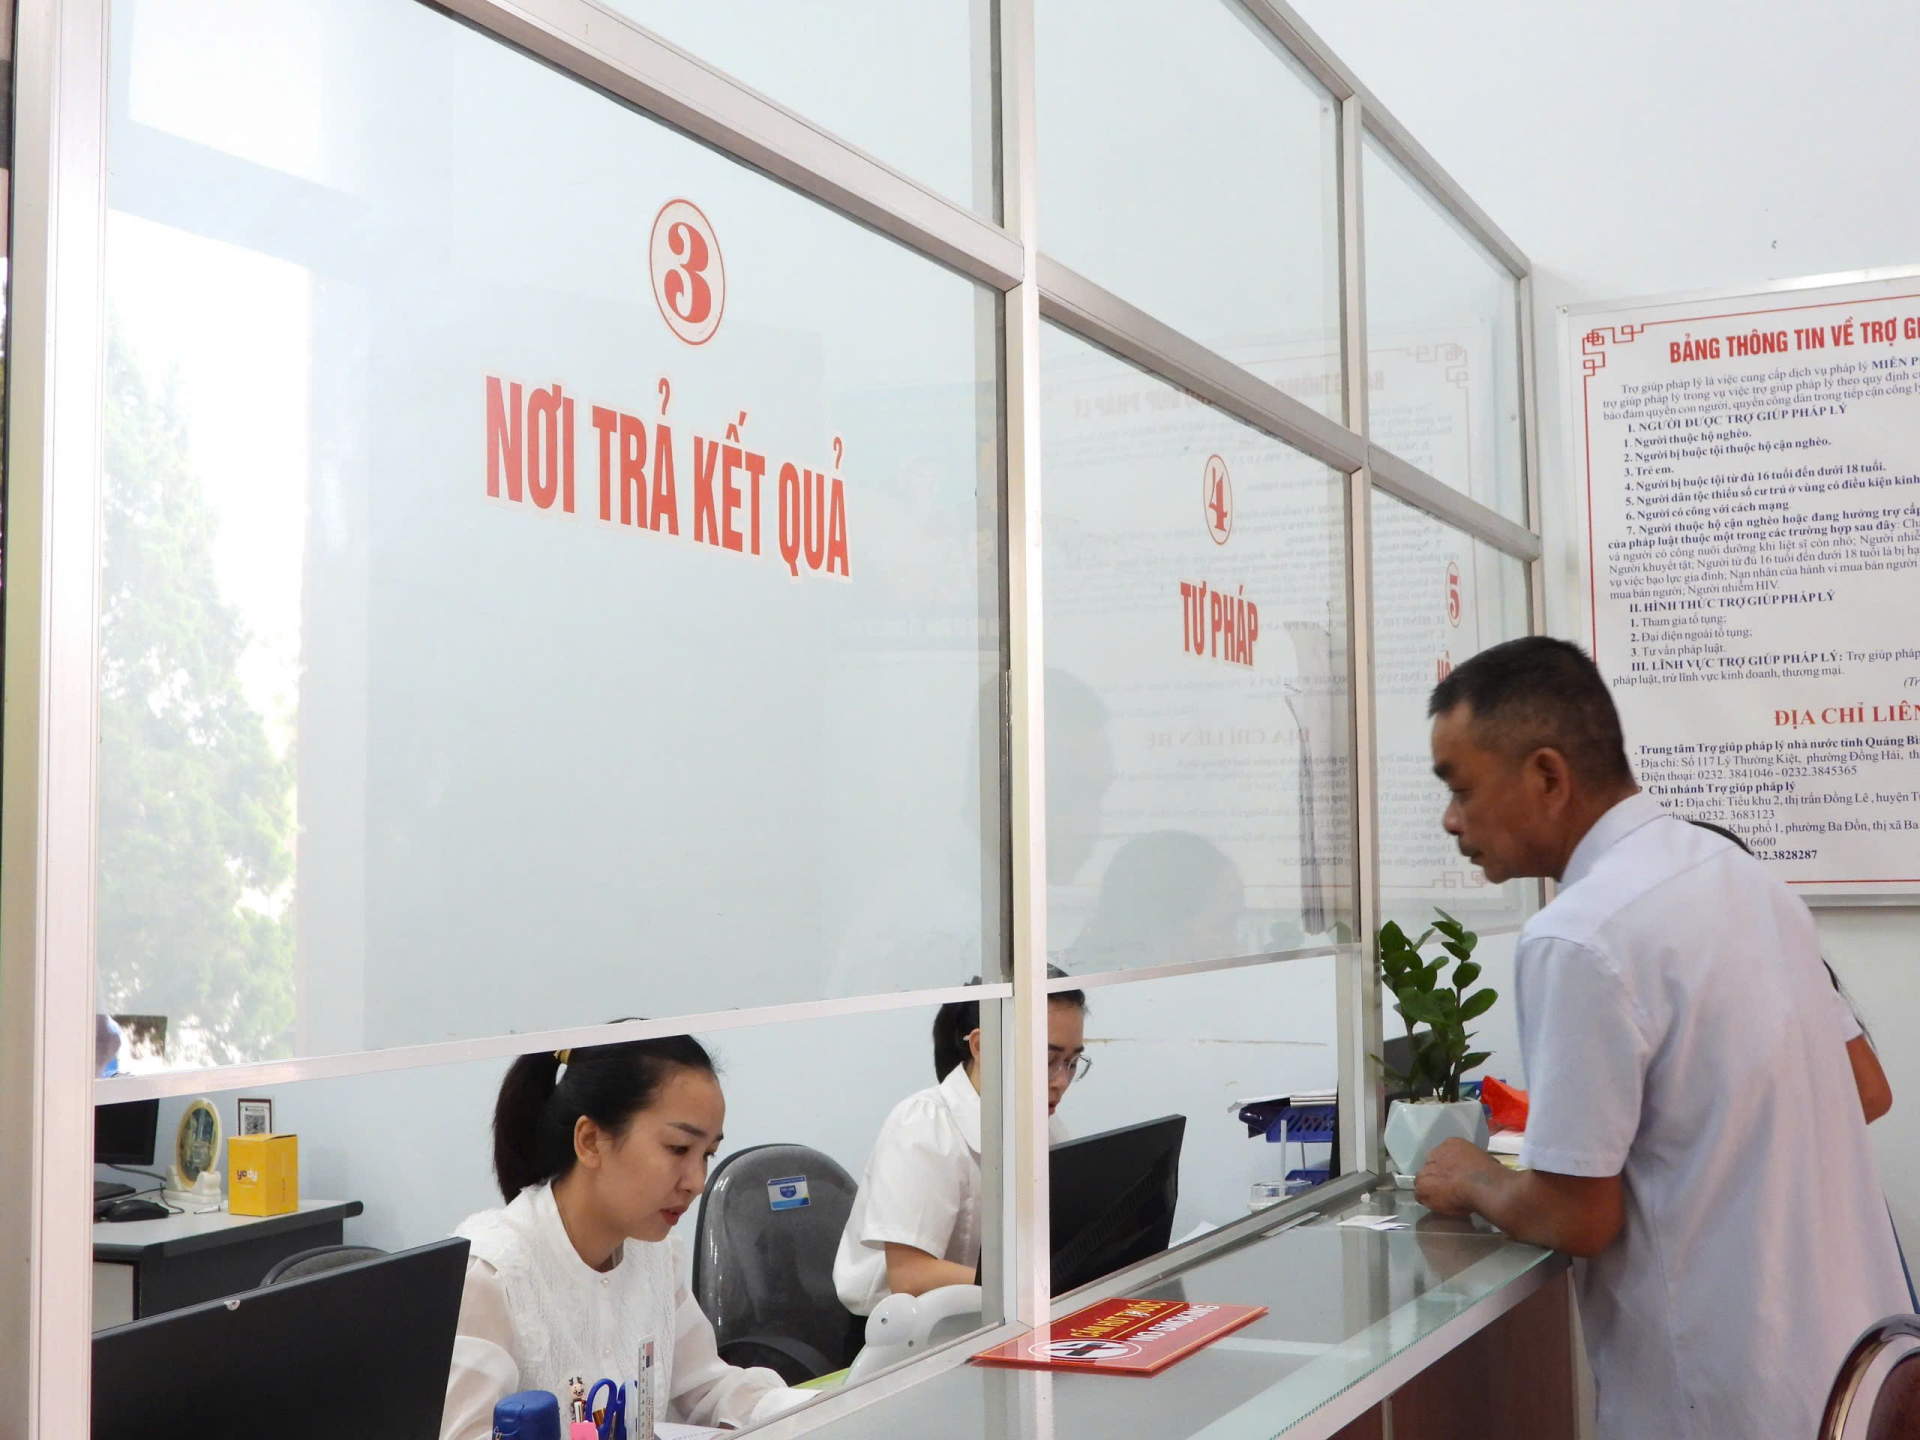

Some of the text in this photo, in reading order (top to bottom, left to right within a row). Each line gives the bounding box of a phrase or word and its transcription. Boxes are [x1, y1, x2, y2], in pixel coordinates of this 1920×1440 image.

[664, 221, 712, 324] 3
[1670, 333, 1719, 363] BẢNG
[1726, 329, 1788, 357] THÔNG
[1794, 327, 1824, 350] TIN
[1831, 316, 1854, 347] VỀ
[1860, 317, 1897, 347] TRỢ
[1620, 370, 1909, 409] giúp pháp trong việc giúp pháp theo định
[1641, 362, 1855, 394] giúp pháp việc cung dịch pháp
[1639, 403, 1827, 431] NGƯỜI ĐƯỢC TRỢ GIÚP PHÁP
[1635, 428, 1751, 449] Người thuộc nghèo.
[1635, 436, 1831, 464] Người buộc tội thuộc cận nghèo.
[486, 375, 850, 577] NƠI TRẢ KẾT QUẢ
[1636, 465, 1843, 493] Người buộc tội đến dưới
[1656, 466, 1674, 474] em.
[1208, 465, 1229, 532] 4
[1637, 474, 1920, 507] Người vùng điều kiện kinh
[1638, 501, 1755, 521] Người công với cách
[1639, 507, 1901, 536] Người thuộc cận nghèo hoặc đang trợ
[1629, 524, 1827, 550] pháp luật thuộc một trong các trường
[1449, 573, 1460, 620] 5
[1645, 590, 1816, 611] HÌNH THỨC GIÚP PHÁP
[1180, 580, 1207, 656] TƯ
[1211, 585, 1259, 667] PHÁP
[1641, 616, 1669, 626] Tham
[1661, 629, 1712, 643] diện ngoài
[1632, 649, 1892, 671] III. LĨNH GIÚP PHÁP giúp
[1678, 644, 1702, 657] pháp
[1613, 666, 1819, 687] pháp lĩnh kinh thương
[1774, 702, 1865, 729] ĐỊA CHỈ
[1640, 736, 1904, 757] Trung giúp pháp nước tỉnh Quảng
[1734, 749, 1879, 767] Thường phường Đồng
[1641, 766, 1857, 783] Điện 3841046 0232.3845365
[1649, 781, 1783, 795] Chi nhánh Trợ giúp pháp
[1801, 791, 1909, 806] trấn Đồng huyện
[1732, 809, 1775, 819] 3683123
[1786, 822, 1825, 834] phường
[1126, 1304, 1220, 1342] NO SMOKING
